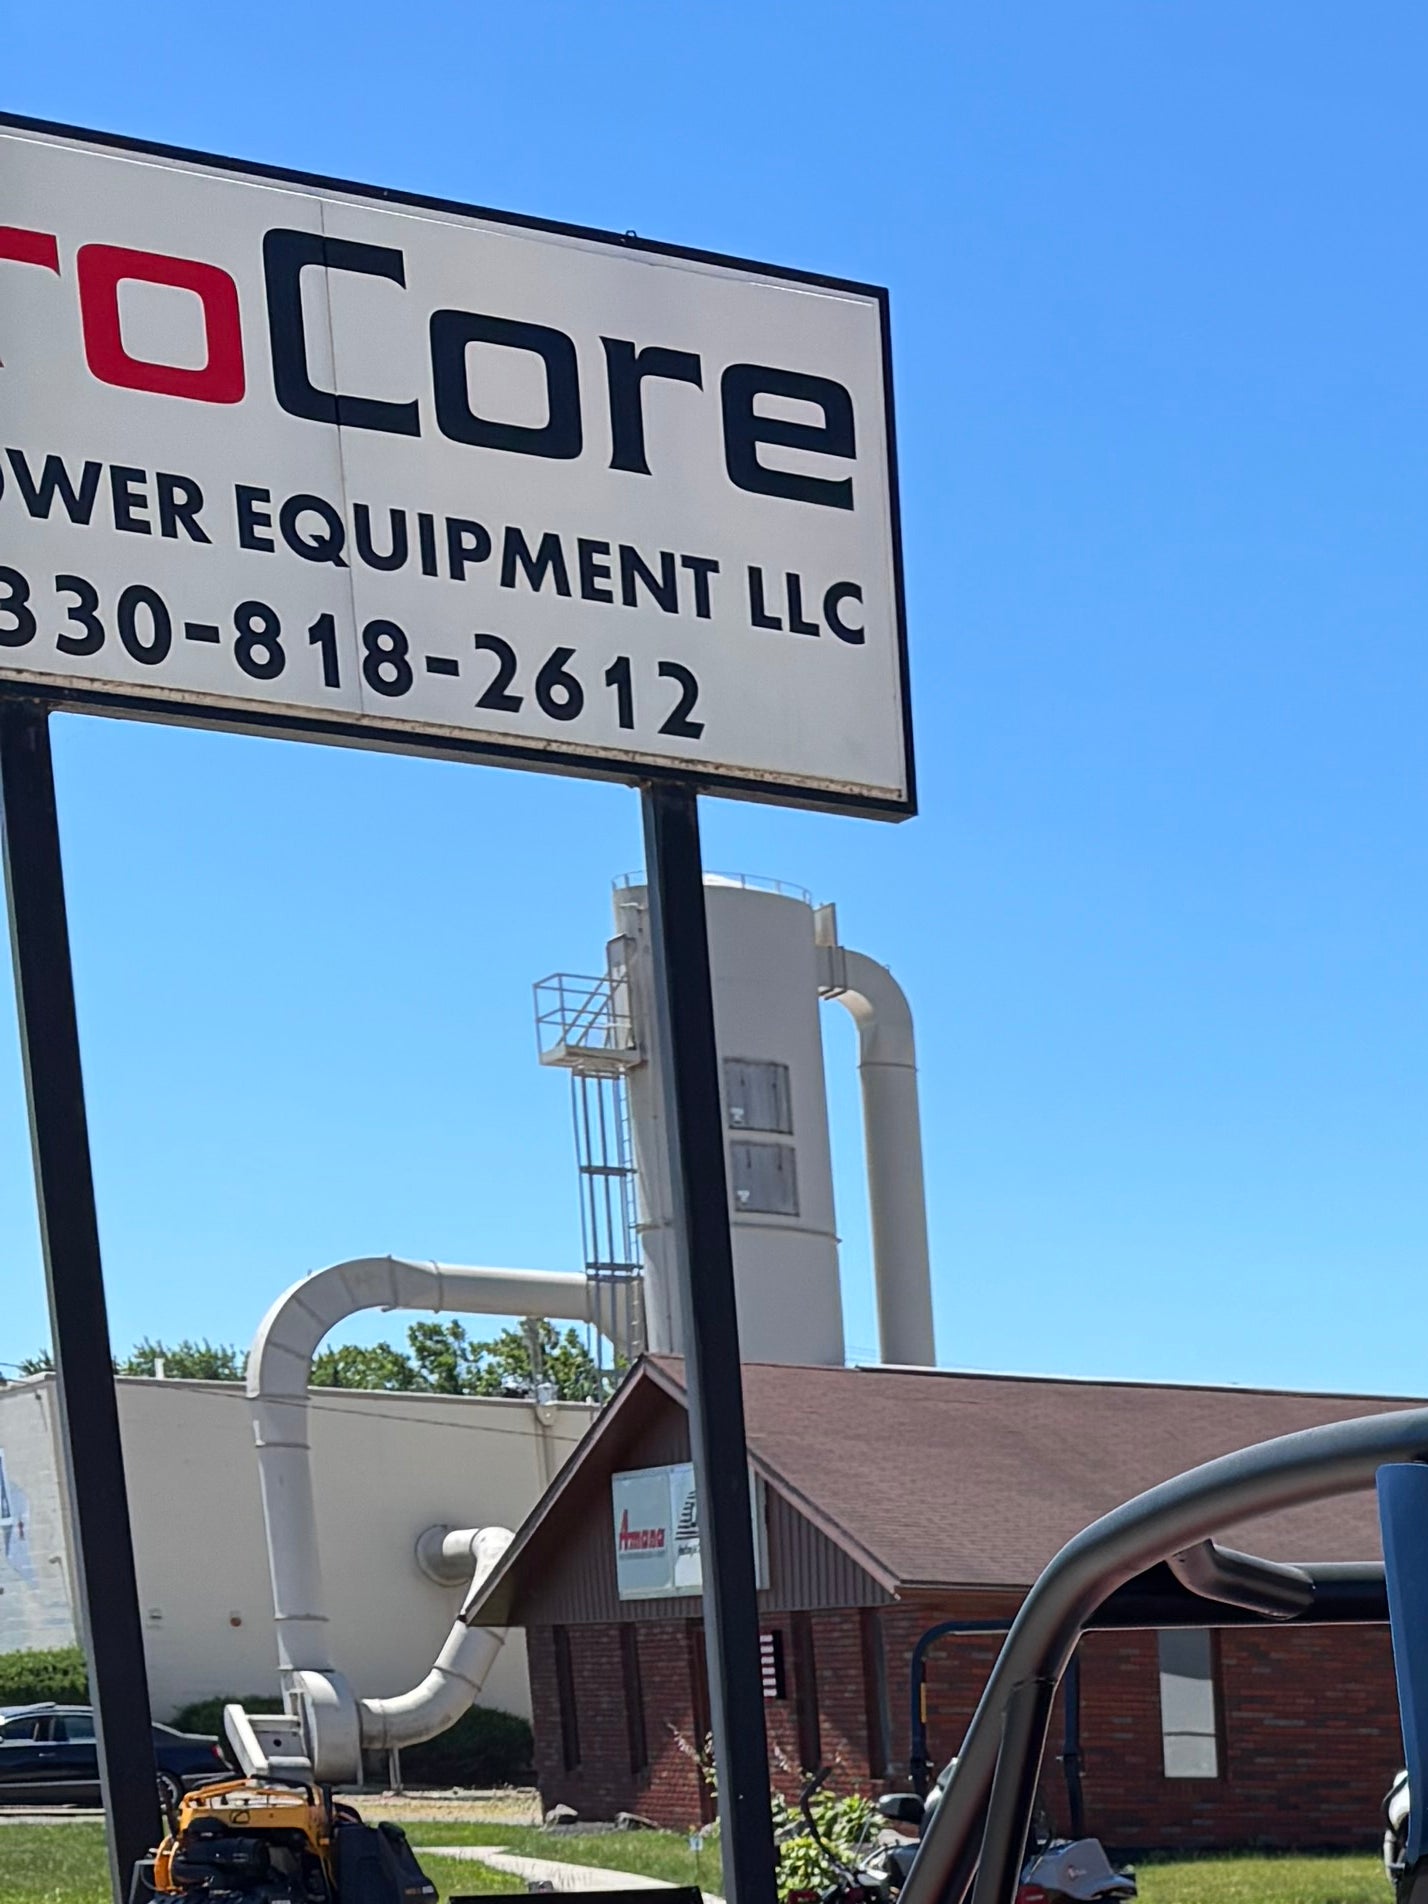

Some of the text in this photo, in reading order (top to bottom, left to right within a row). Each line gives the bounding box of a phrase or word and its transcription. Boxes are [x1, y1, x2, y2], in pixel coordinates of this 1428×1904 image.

[0, 447, 867, 646] WER EQUIPMENT LLC
[0, 566, 706, 740] 330-818-2612
